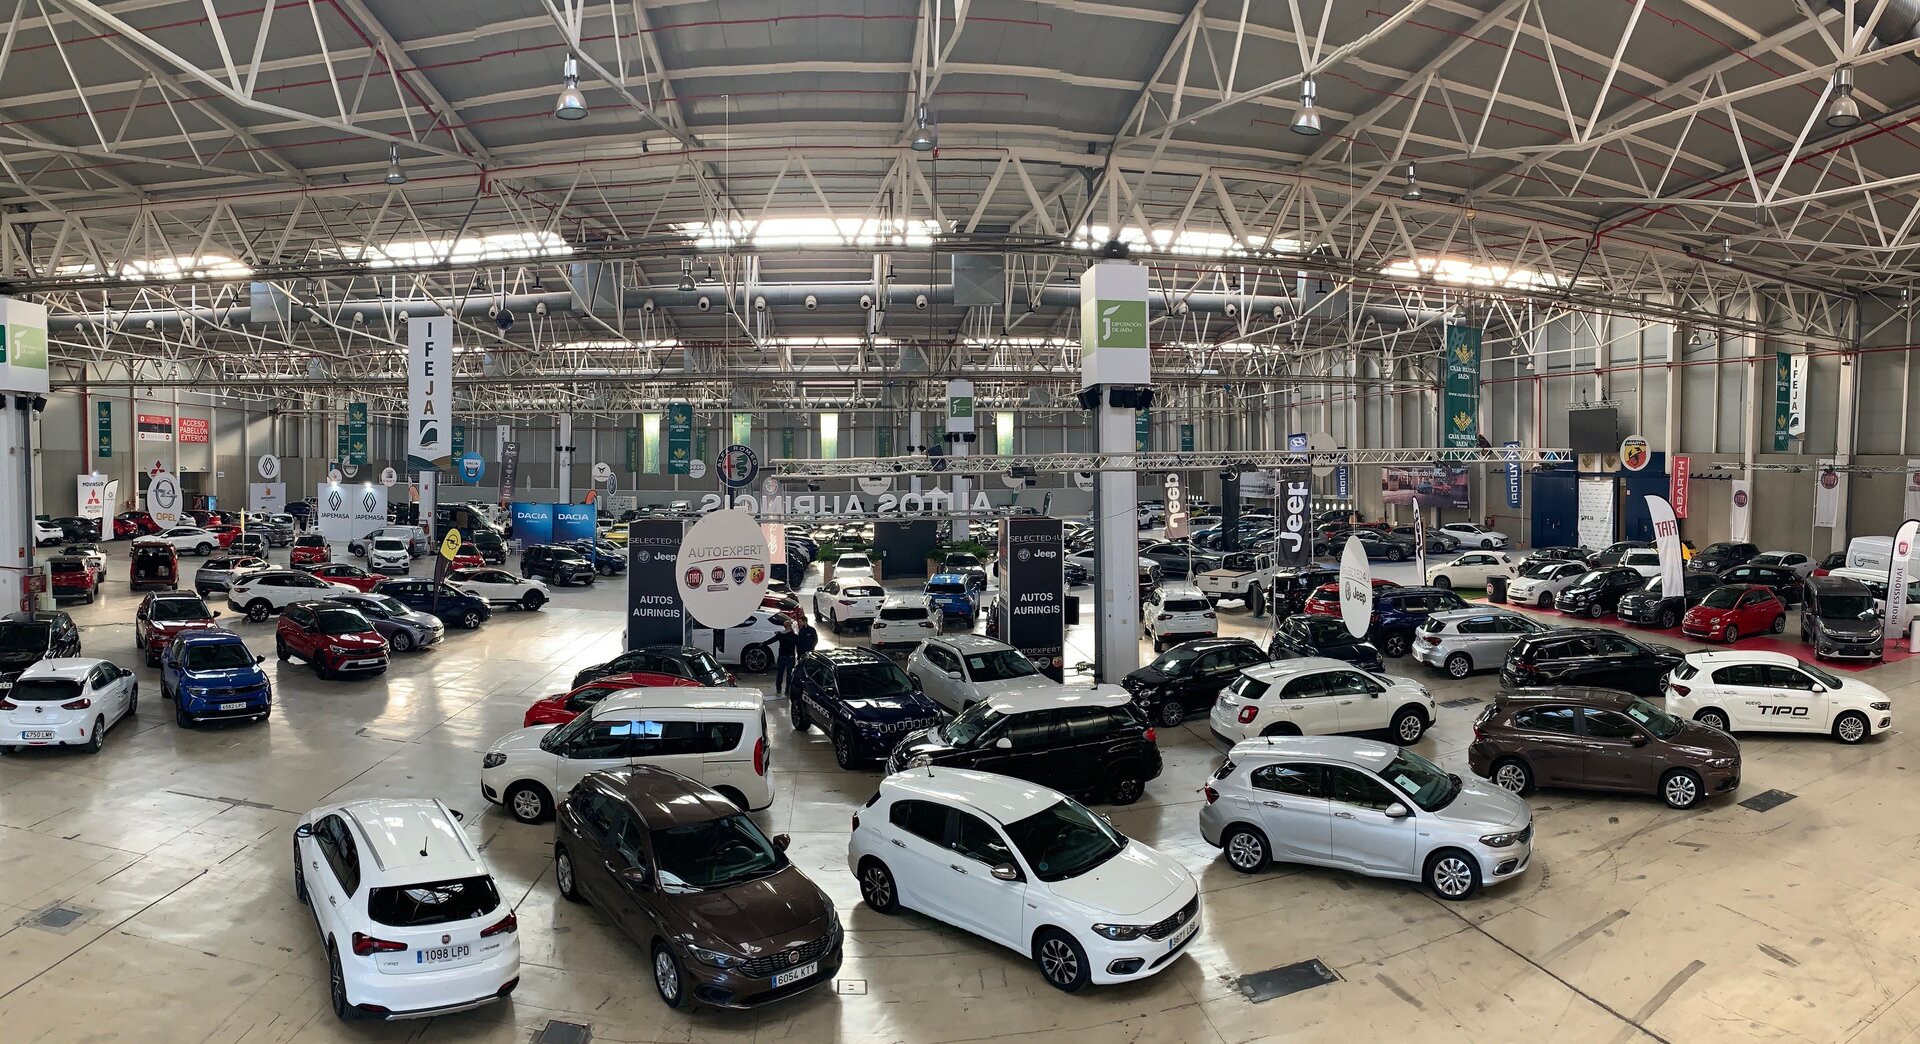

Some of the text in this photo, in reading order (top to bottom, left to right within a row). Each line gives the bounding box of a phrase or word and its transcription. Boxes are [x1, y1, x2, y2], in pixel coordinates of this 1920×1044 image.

[183, 418, 206, 428] ACCESO
[181, 434, 208, 443] EXTERIOR
[733, 445, 758, 467] ROMEO
[1676, 460, 1685, 515] ABARTH
[156, 512, 176, 522] OPEL
[688, 545, 764, 558] AUTOEXPERT
[1033, 549, 1057, 559] Jeep
[653, 552, 677, 562] Jeep
[689, 573, 700, 584] FIAT
[639, 595, 674, 605] AUTOS
[1020, 592, 1054, 602] AUTOS
[1353, 586, 1367, 606] Jeep
[1891, 567, 1904, 625] PROFESSIONAL
[633, 608, 681, 618] AURINGIS
[1013, 605, 1061, 615] AURINGIS
[1018, 646, 1062, 654] UTOEXPERT
[1758, 705, 1809, 716] TIPO
[424, 948, 449, 961] 1098
[451, 945, 470, 958] LPD
[778, 963, 816, 985] 6054 KTY
